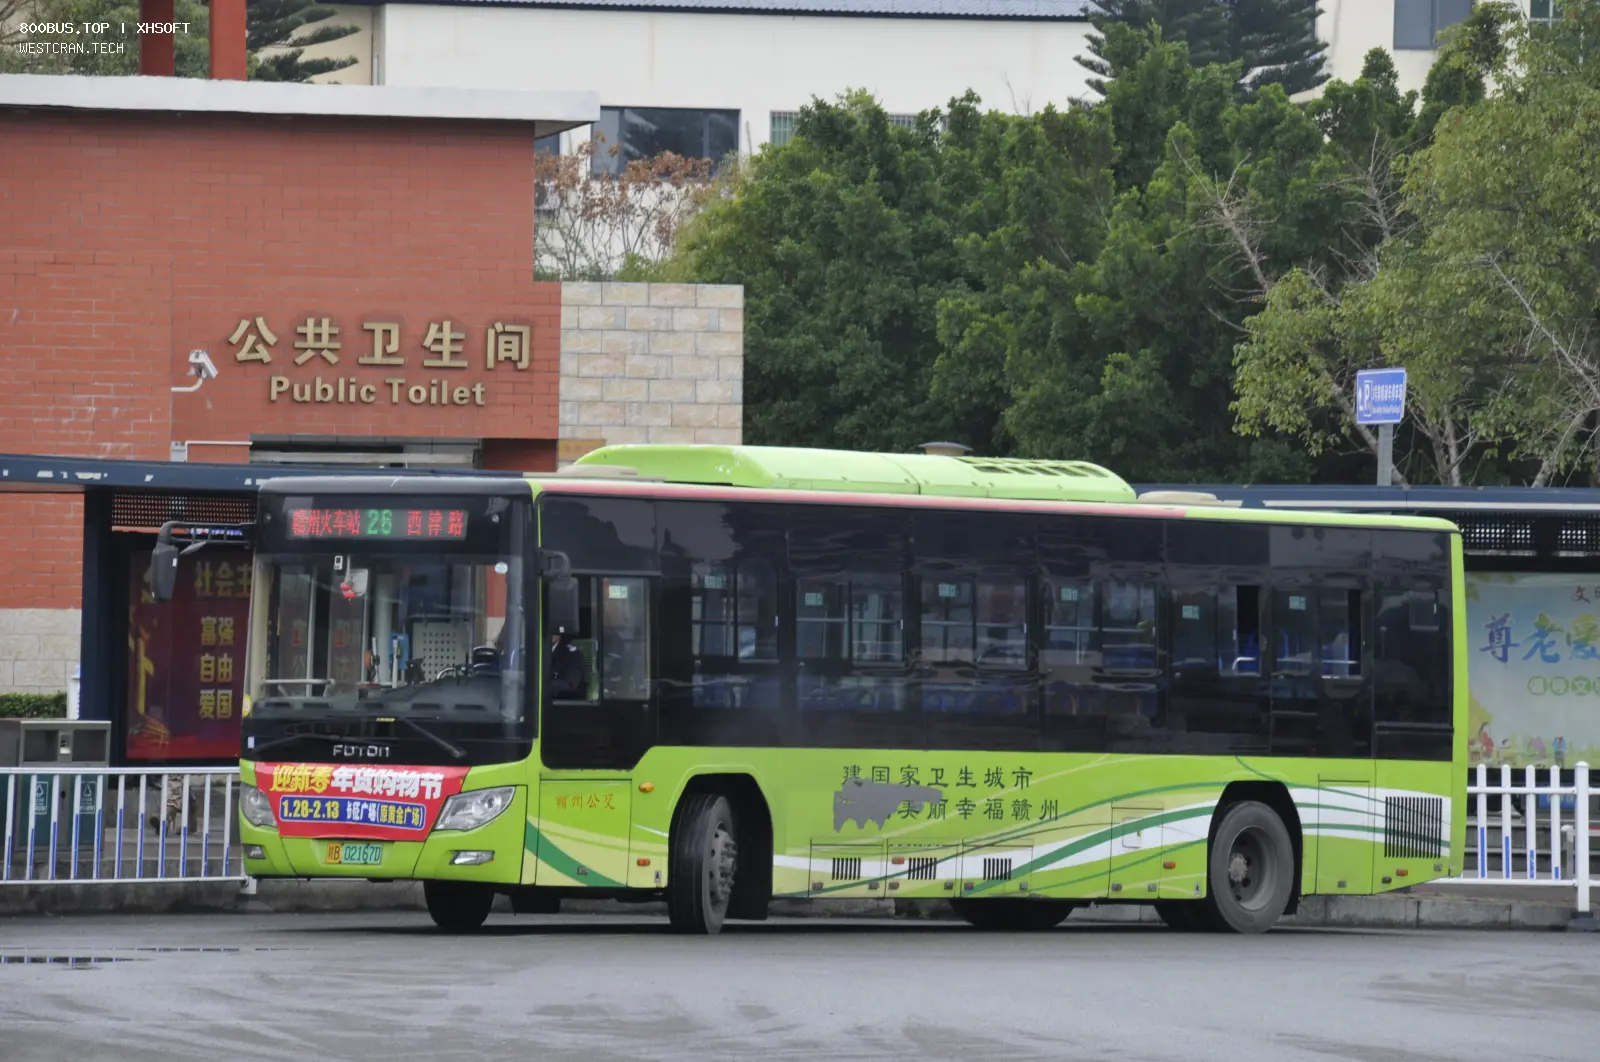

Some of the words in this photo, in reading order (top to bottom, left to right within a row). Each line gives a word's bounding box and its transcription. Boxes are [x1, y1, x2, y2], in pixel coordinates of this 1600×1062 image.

[228, 316, 532, 370] 公共卫生间
[269, 375, 377, 404] Public
[385, 378, 486, 407] Toilet
[366, 508, 394, 536] 26
[200, 615, 235, 646] 富强
[200, 652, 234, 684] 自由
[199, 688, 233, 720] 爱国
[332, 744, 390, 758] FOTON
[841, 763, 1034, 791] 建国家卫生城市
[281, 799, 340, 820] 1.28-2.13
[886, 797, 1059, 822] 美丽幸福赣州
